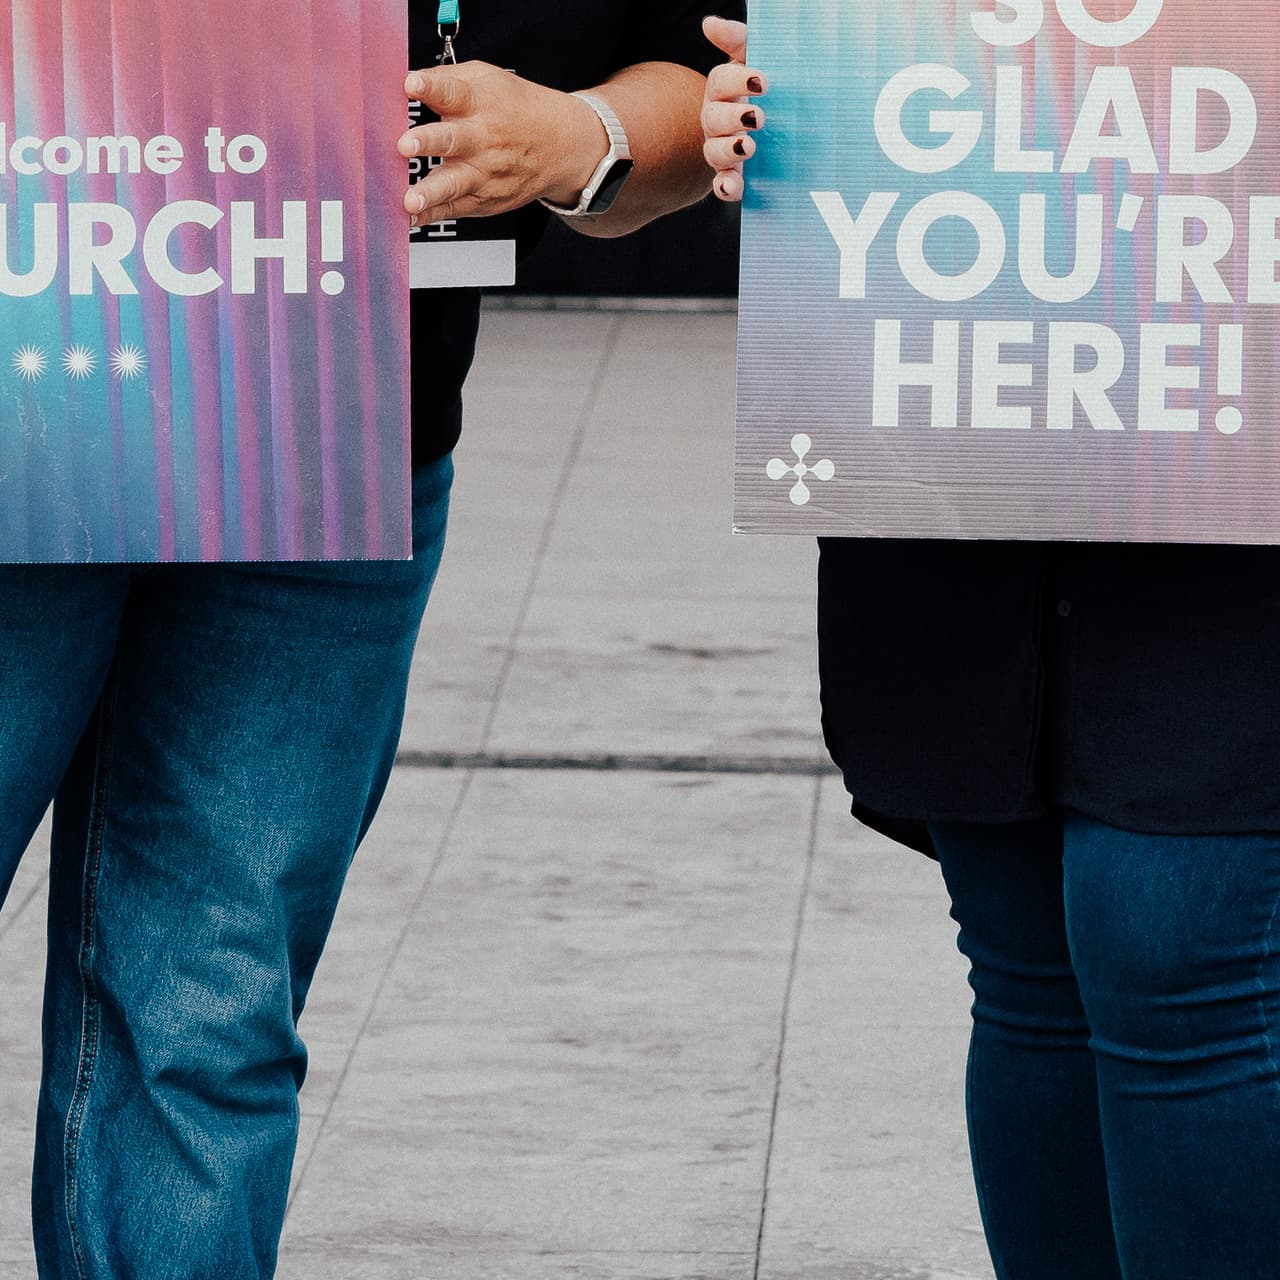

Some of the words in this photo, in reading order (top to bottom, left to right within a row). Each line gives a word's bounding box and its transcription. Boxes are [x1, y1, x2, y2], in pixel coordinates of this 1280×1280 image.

[203, 126, 268, 175] to
[873, 62, 1258, 175] GLAD
[871, 318, 1244, 435] HERE!
